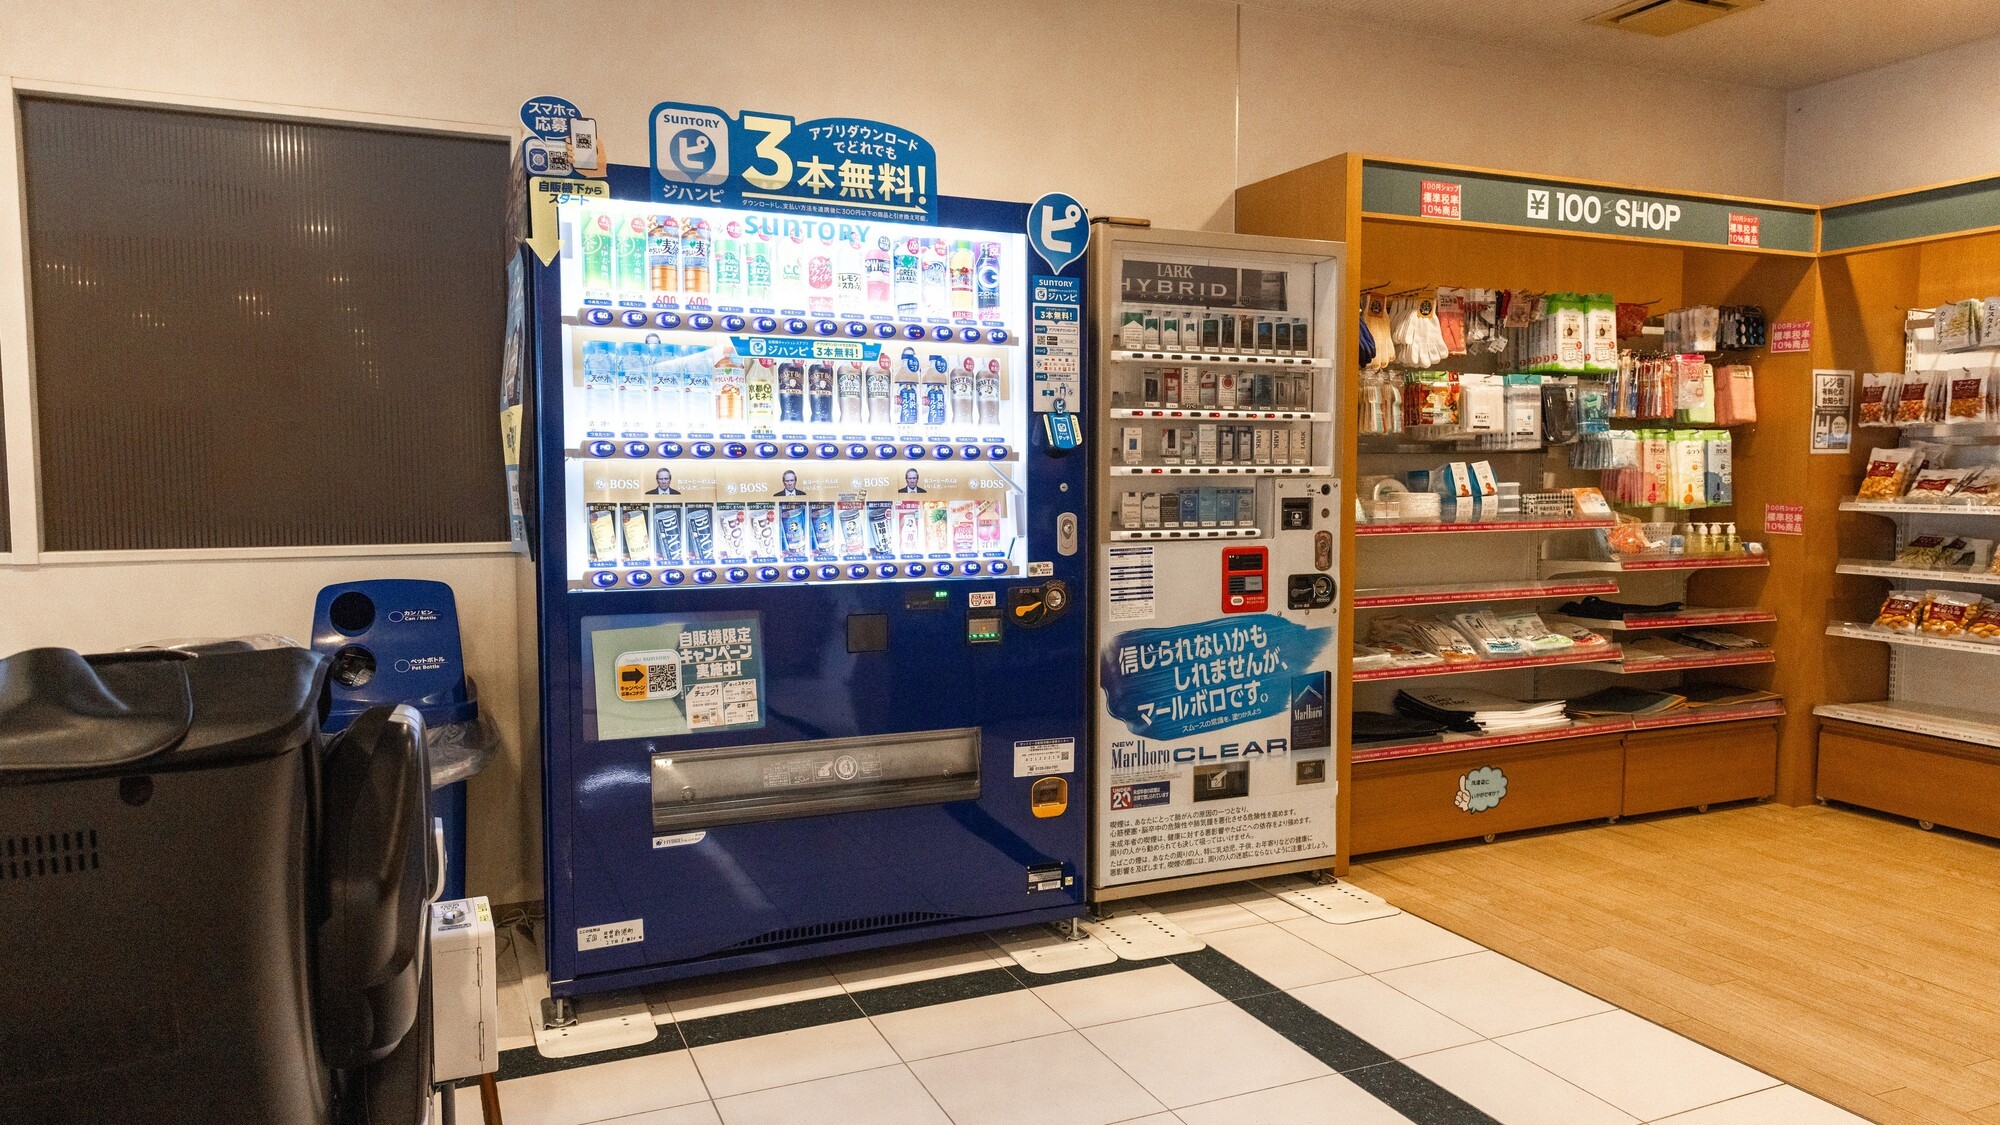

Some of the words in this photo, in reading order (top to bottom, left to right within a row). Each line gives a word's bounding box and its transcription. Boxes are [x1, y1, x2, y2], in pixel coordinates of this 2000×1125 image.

[528, 102, 575, 117] スマホで
[535, 116, 568, 133] 応募
[663, 114, 719, 128] SUNTORY
[808, 123, 919, 151] アプリダウンロード
[833, 141, 897, 160] でどれでも
[538, 181, 602, 195] 自販機下から
[662, 184, 724, 203] ジハンピ
[1423, 182, 1459, 193] 100円ショップ
[549, 193, 590, 206] スタート
[1423, 191, 1459, 205] 標準税率
[1423, 204, 1459, 217] 10%商品
[1556, 191, 1601, 224] 100
[1614, 198, 1681, 231] SHOP
[744, 215, 871, 243] SUNTORY
[1156, 264, 1193, 279] LARK
[1039, 279, 1073, 288] SUNTORY
[1121, 278, 1228, 297] HYBRID
[1048, 292, 1078, 302] ジハンピ
[1773, 321, 1811, 330] 100円ショップ
[1773, 329, 1810, 341] 標準税率
[1773, 339, 1810, 349] 10%商品
[768, 345, 809, 357] ジハンピ
[816, 347, 859, 358] 3本無料!
[590, 374, 613, 383] 天然水
[623, 375, 646, 384] 天然水
[657, 376, 677, 385] 天然水
[689, 377, 710, 386] 天然水
[1823, 377, 1845, 388] レジ袋
[1822, 388, 1845, 397] 有料化の
[1822, 396, 1844, 405] お知らせ
[610, 479, 640, 489] BOSS
[740, 482, 768, 493] BOSS
[864, 478, 889, 487] BOSS
[980, 479, 1004, 489] BOSS
[1767, 504, 1804, 512] 100円ショップ
[1767, 512, 1803, 523] 標準税率
[1767, 522, 1802, 533] 10%商品
[663, 513, 682, 560] BLACK
[694, 513, 714, 560] BLACK
[679, 627, 752, 647] 自販機限定
[680, 645, 753, 664] キャンペーン
[1118, 624, 1268, 676] 信じられないかも
[410, 656, 446, 664] ペットボトル
[696, 661, 742, 678] 実施中!
[1174, 646, 1289, 692] しれませんが、
[694, 688, 719, 697] チェック!
[1137, 680, 1269, 726] マールボロです。
[1293, 704, 1323, 721] Marlboro
[1182, 708, 1262, 733] スムースの常識を、塗りかえよう
[1111, 740, 1134, 748] NEW
[1173, 738, 1288, 763] CLEAR
[1111, 739, 1170, 770] Marlboro
